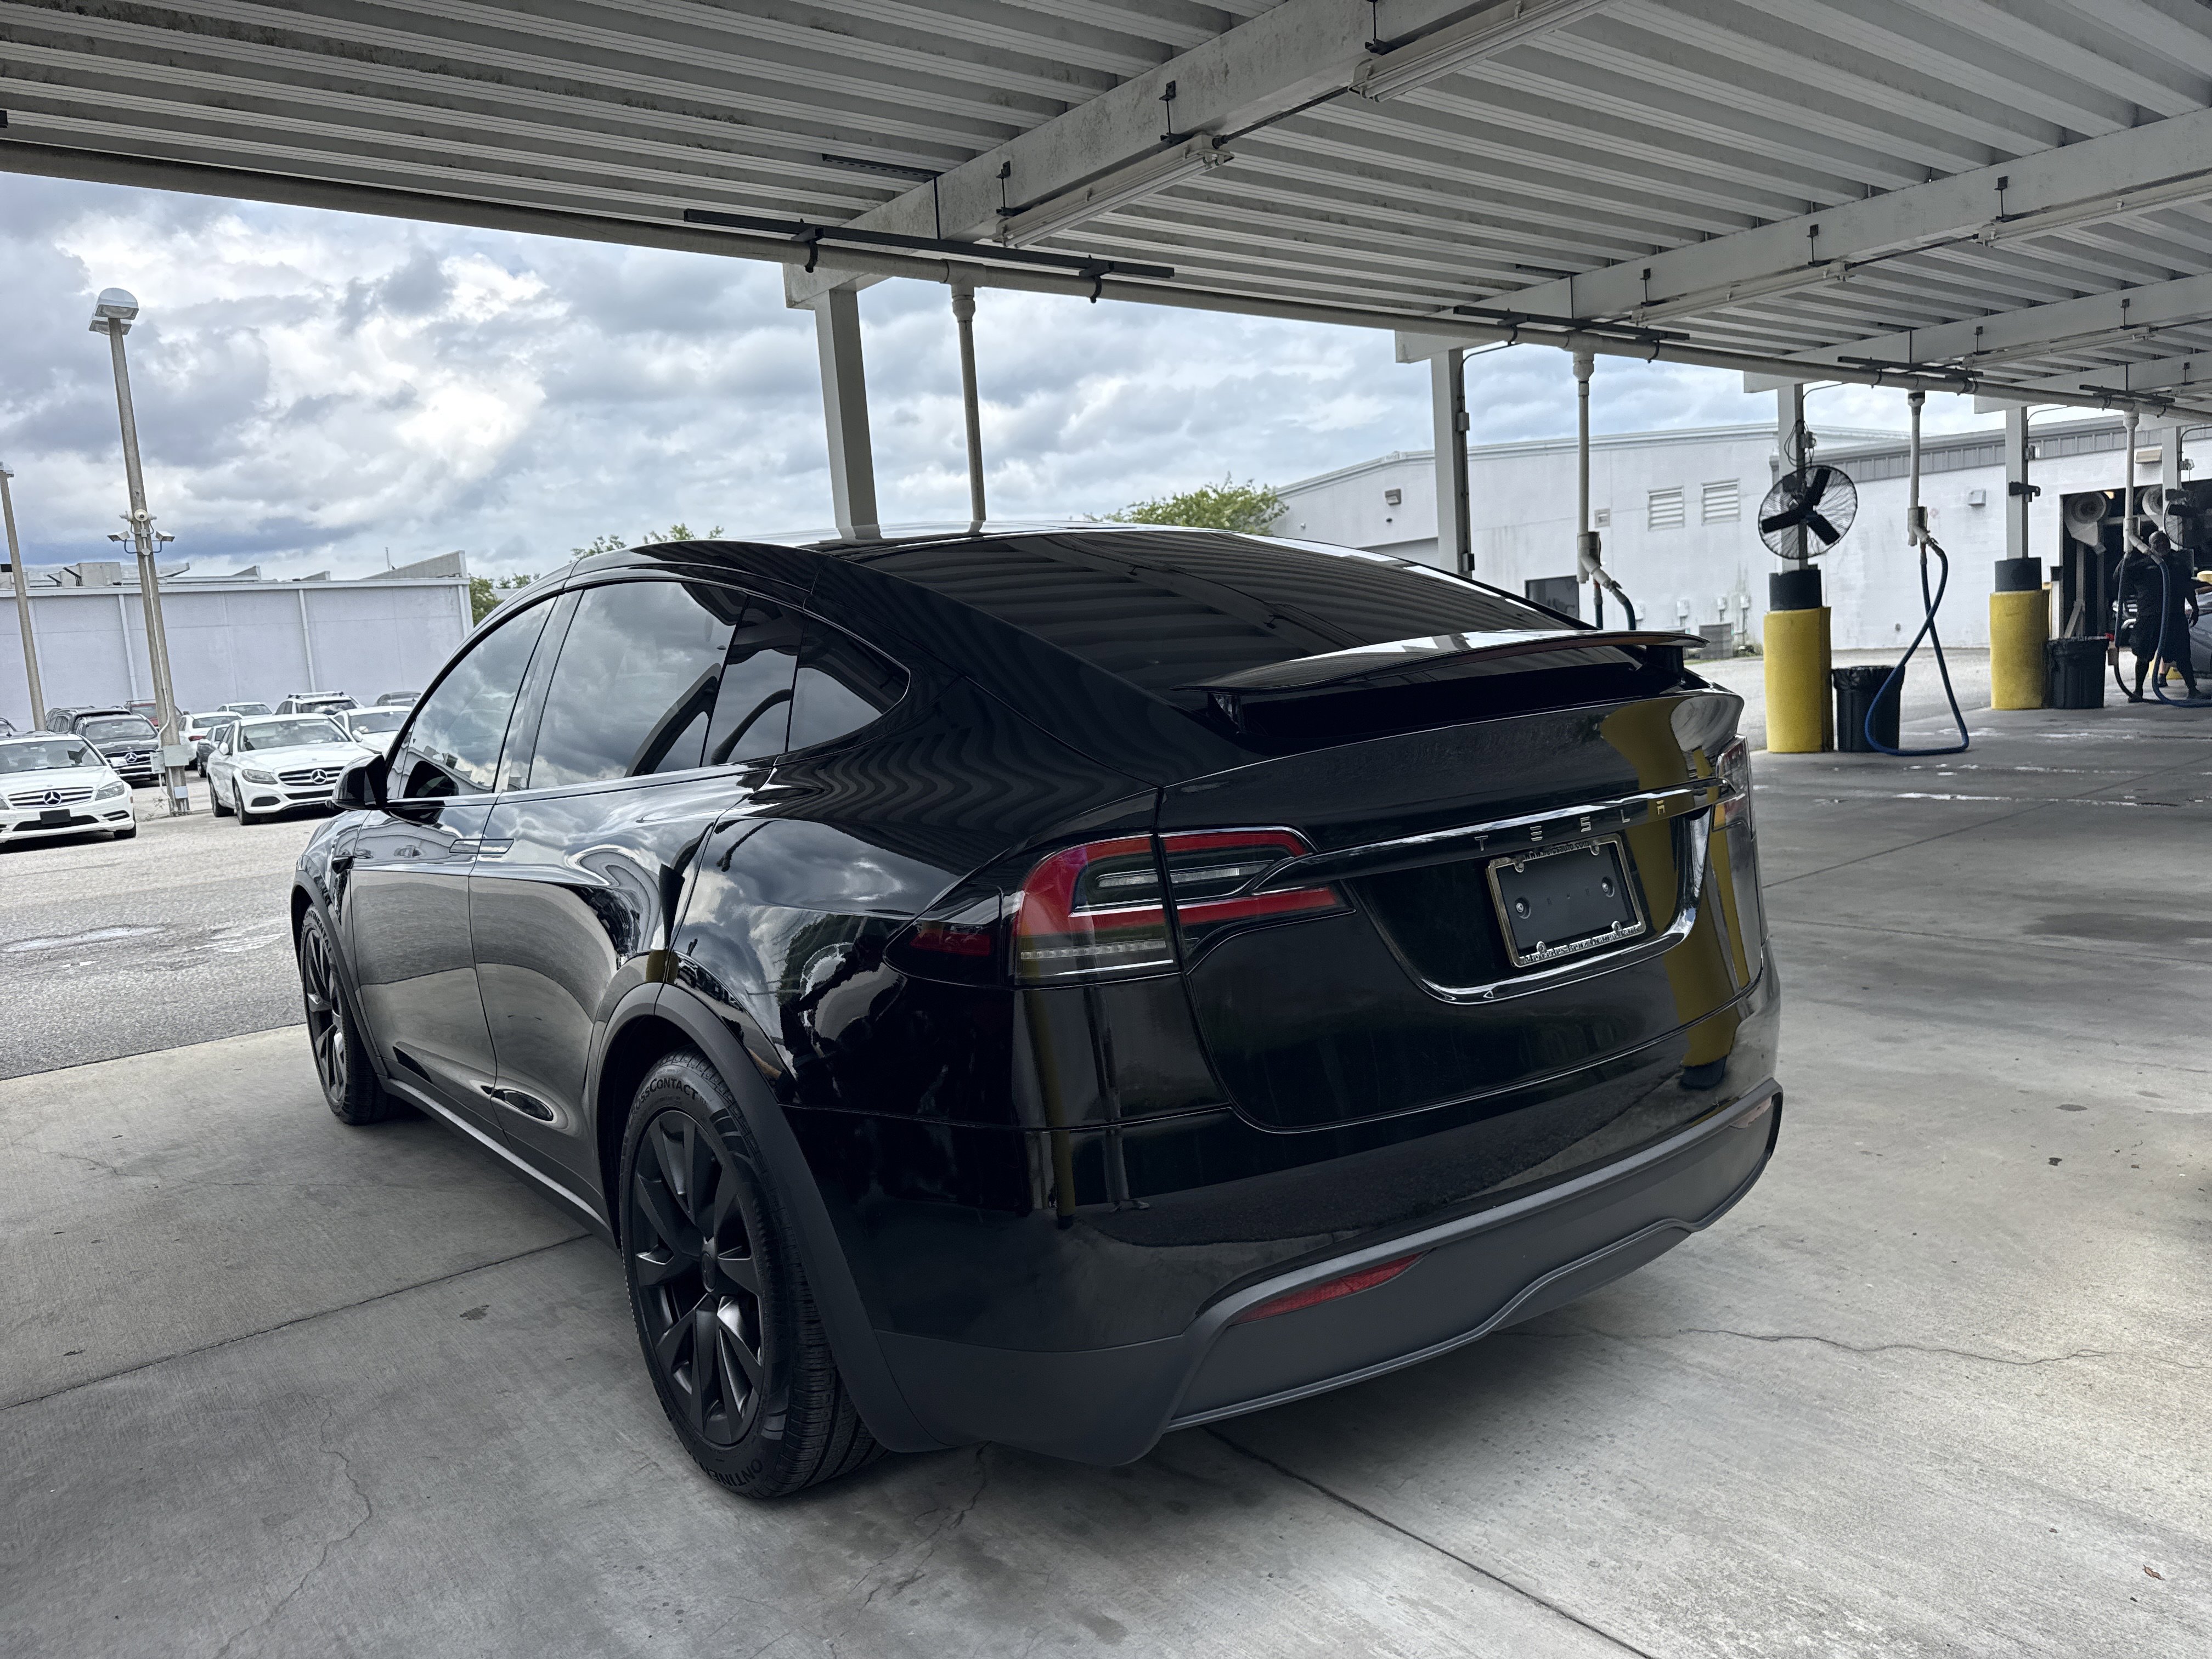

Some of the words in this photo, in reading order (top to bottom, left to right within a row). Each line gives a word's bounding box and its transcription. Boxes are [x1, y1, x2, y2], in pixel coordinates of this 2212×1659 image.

[1474, 799, 1666, 851] TESLA
[1524, 840, 1589, 860] www.edsauto.com
[304, 909, 331, 953] ONTINENTAL
